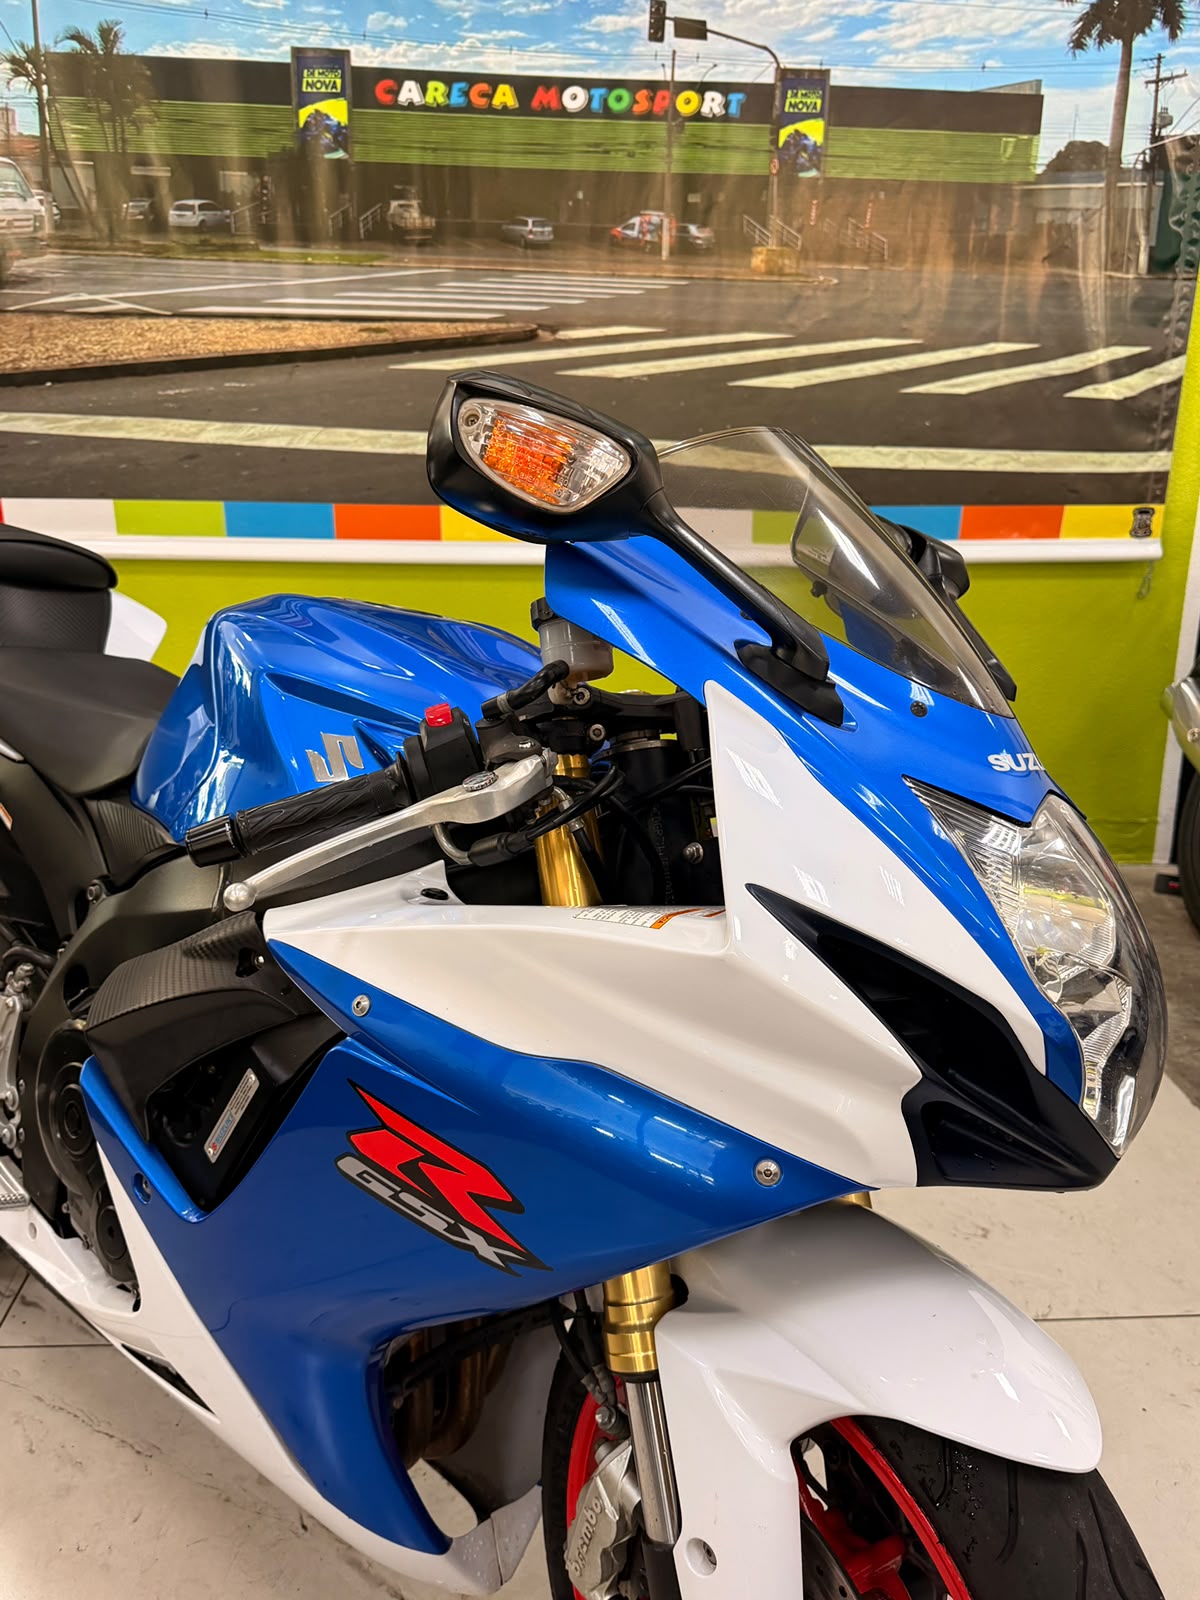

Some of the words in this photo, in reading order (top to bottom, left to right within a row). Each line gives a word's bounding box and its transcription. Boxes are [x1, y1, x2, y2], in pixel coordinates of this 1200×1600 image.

[305, 79, 338, 91] NOVA
[375, 79, 519, 109] CARECA
[531, 85, 747, 117] MOTOSPORT
[788, 100, 818, 111] NOVA
[987, 753, 1045, 772] SUZ
[336, 1155, 529, 1268] GSX
